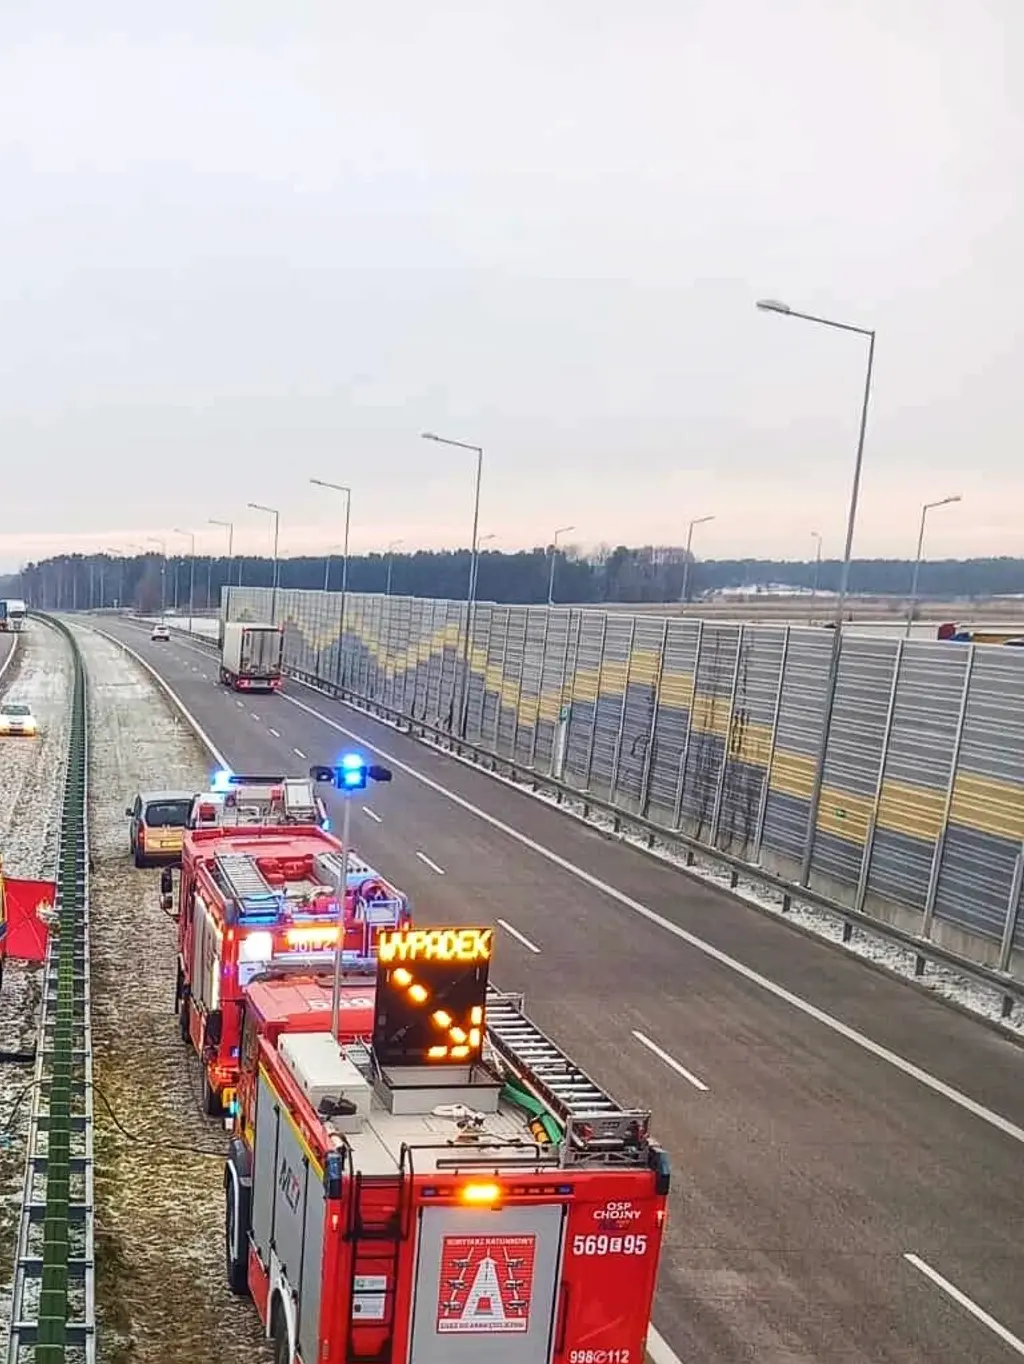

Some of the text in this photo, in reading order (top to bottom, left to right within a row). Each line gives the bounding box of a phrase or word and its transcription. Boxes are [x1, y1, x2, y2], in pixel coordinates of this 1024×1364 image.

[379, 929, 492, 961] WYPADEK
[606, 1201, 633, 1211] OSP
[593, 1209, 641, 1220] CHOJNY
[569, 1349, 630, 1364] 998 112
